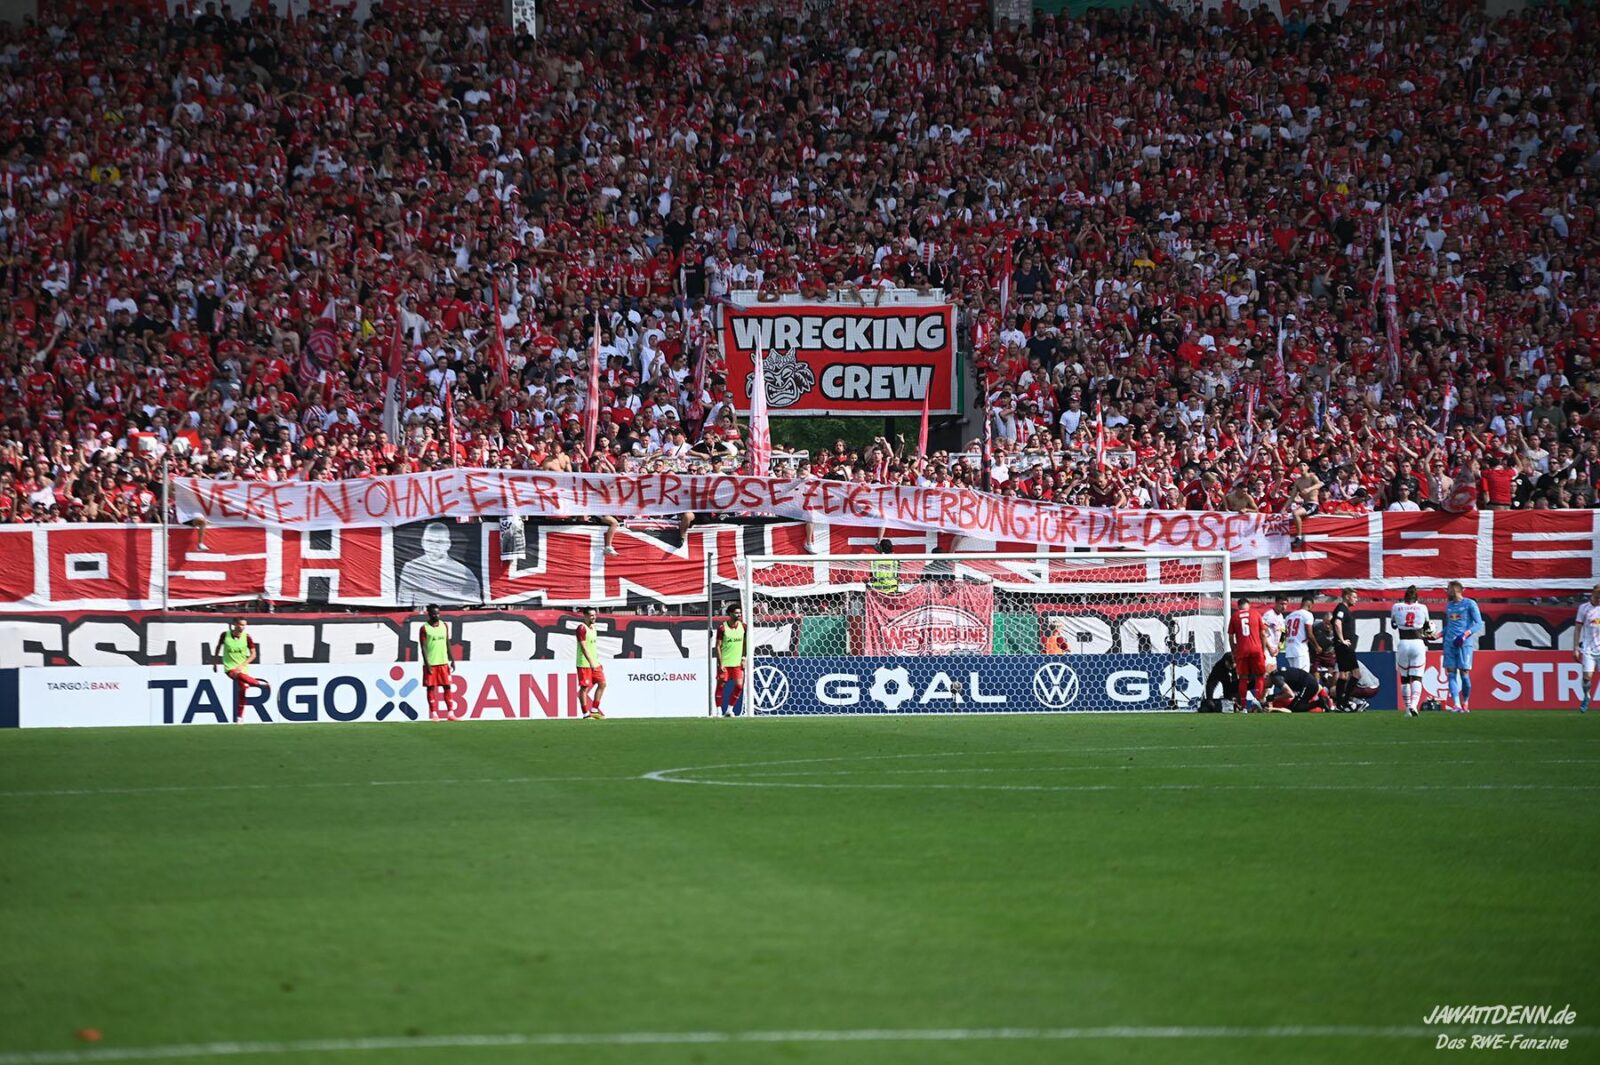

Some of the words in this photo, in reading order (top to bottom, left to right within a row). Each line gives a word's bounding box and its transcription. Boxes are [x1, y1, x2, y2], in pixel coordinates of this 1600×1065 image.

[731, 314, 946, 351] WRECKING
[820, 364, 935, 401] CREW
[364, 475, 459, 518] OHNE
[616, 474, 680, 510] DER
[690, 475, 794, 510] HOSE
[802, 480, 893, 519] ZEIGT
[895, 486, 1031, 540] WERBUNG
[1240, 617, 1251, 637] 6
